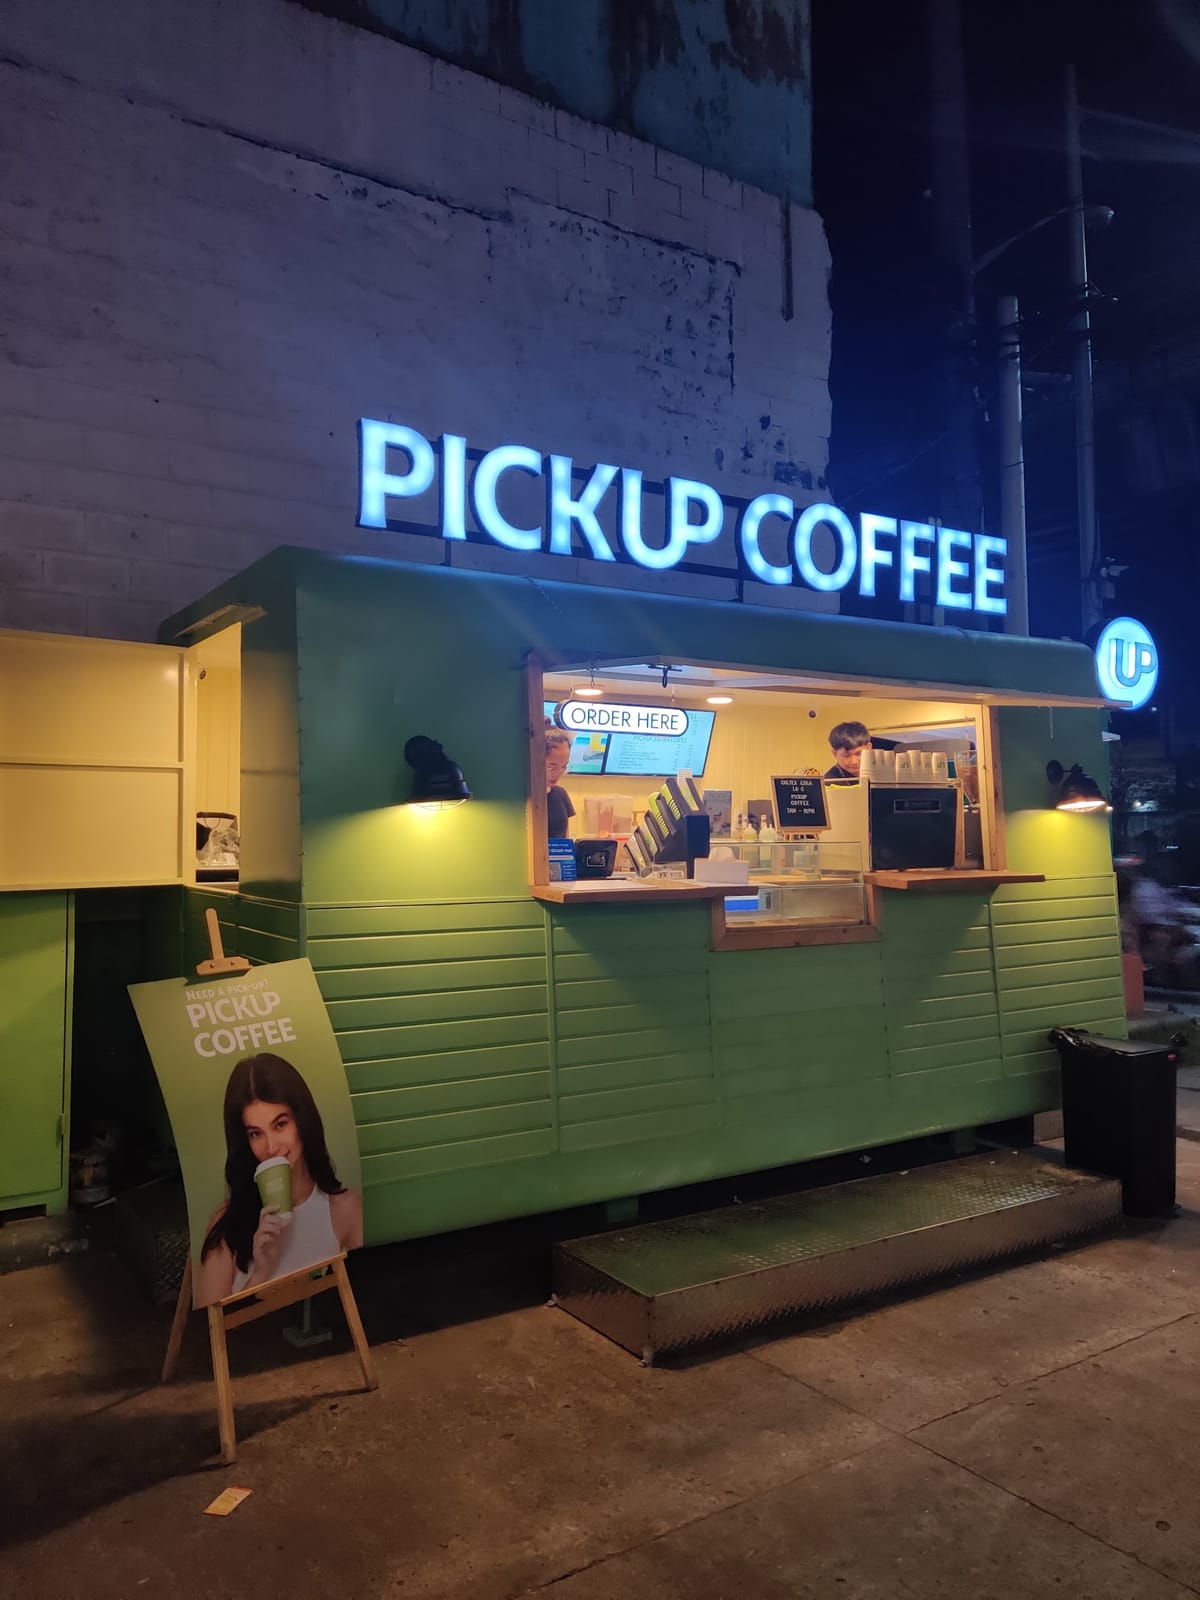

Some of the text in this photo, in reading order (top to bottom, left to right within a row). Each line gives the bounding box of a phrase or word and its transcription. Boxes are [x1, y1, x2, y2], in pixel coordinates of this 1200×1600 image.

[358, 418, 1008, 615] PICKUP COFFEE
[1108, 637, 1157, 688] UP
[571, 707, 631, 728] ORDER
[637, 712, 679, 731] HERE
[185, 991, 281, 1029] PICKUP
[194, 1017, 297, 1058] COFFEE
